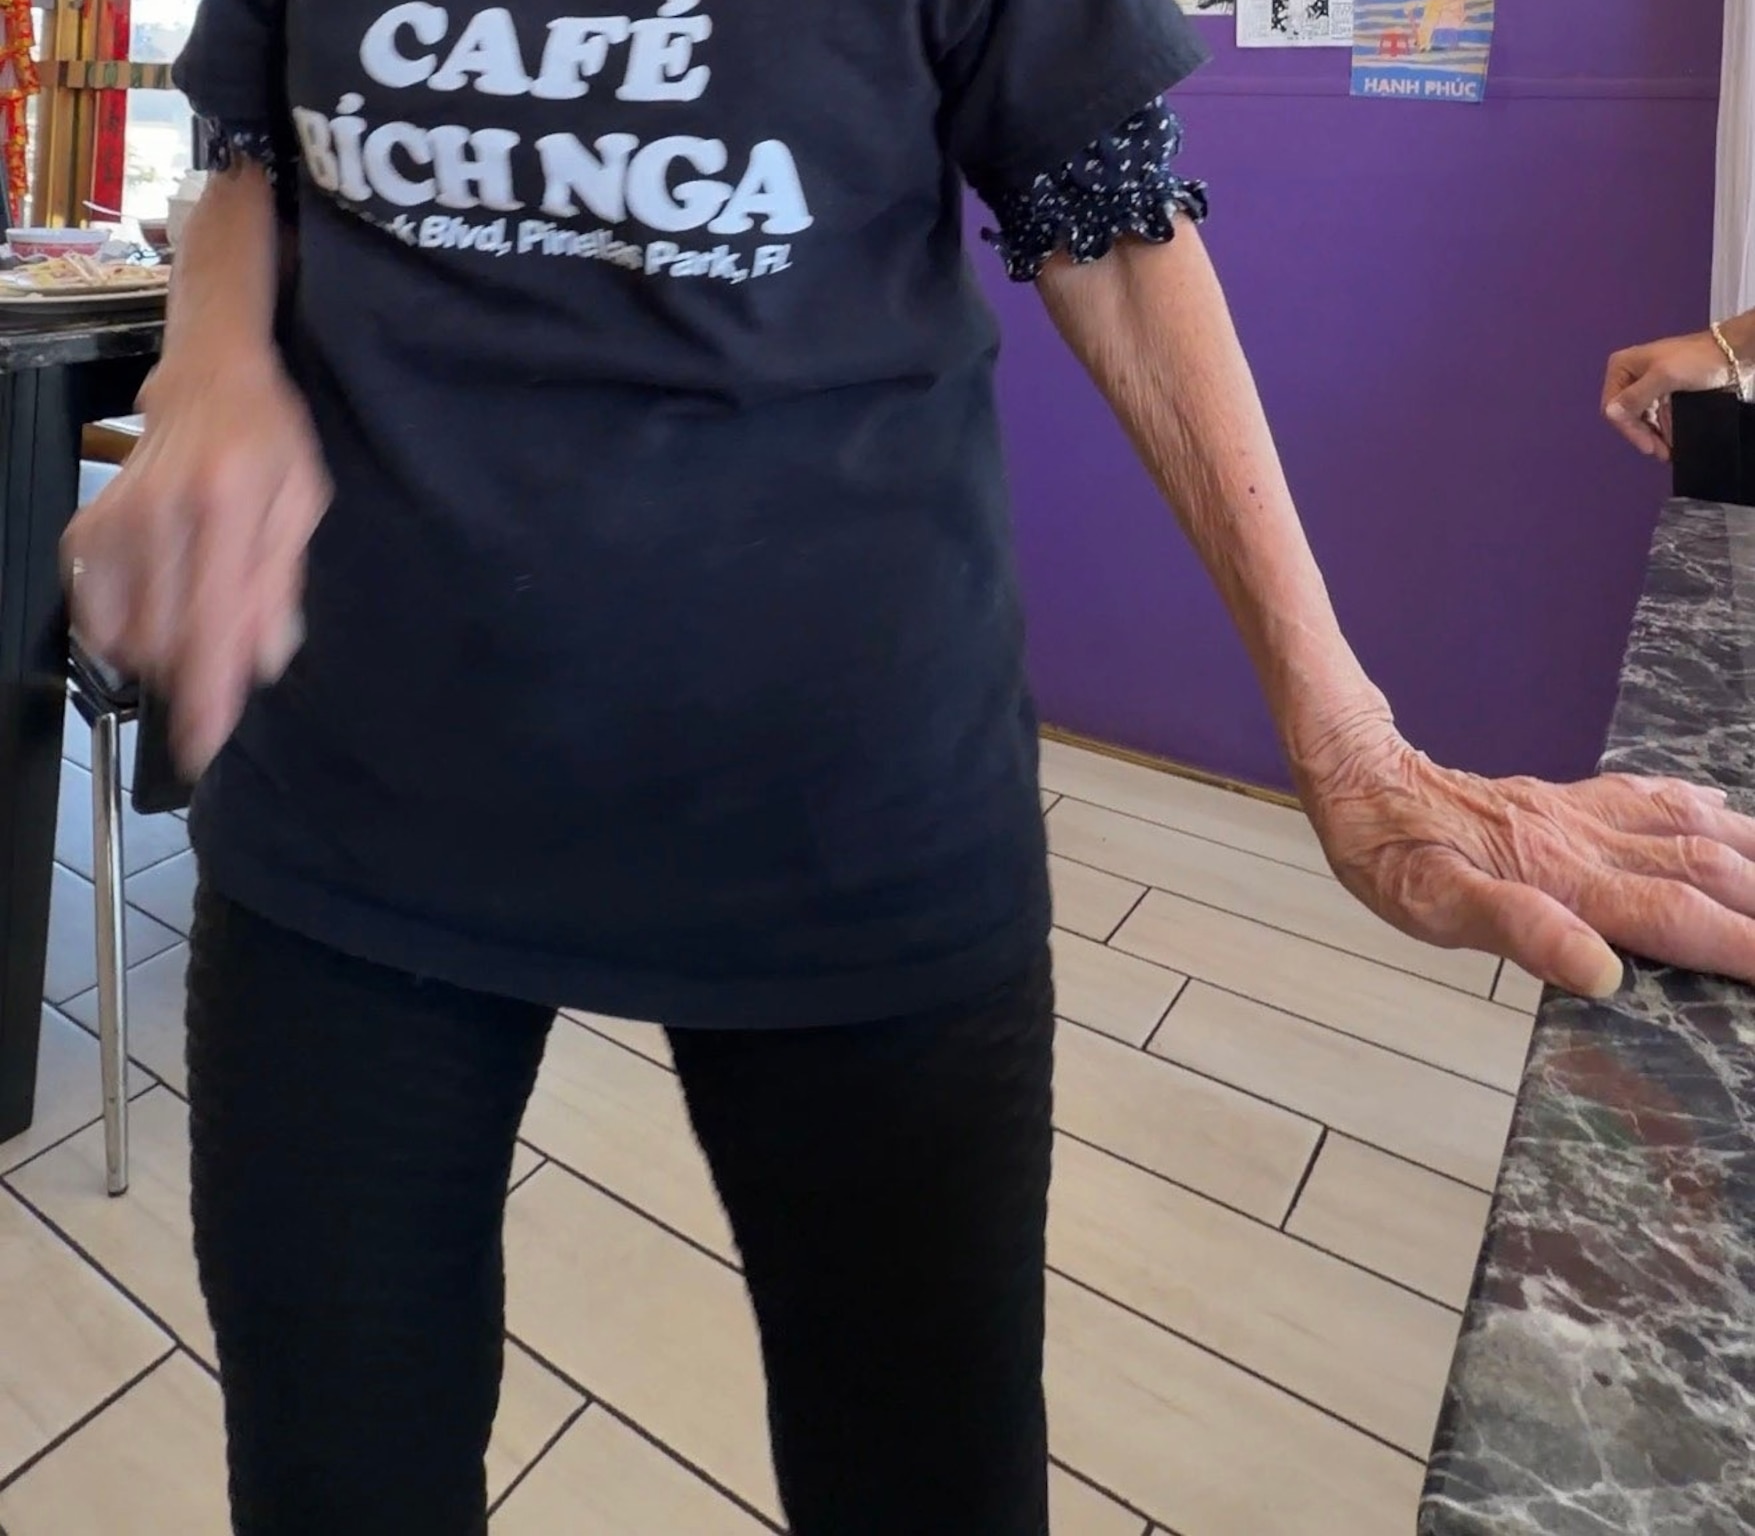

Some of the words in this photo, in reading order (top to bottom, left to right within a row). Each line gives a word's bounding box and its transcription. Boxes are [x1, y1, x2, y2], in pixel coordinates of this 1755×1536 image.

[1424, 76, 1476, 97] PHÚC
[293, 92, 526, 212] BÍCH
[535, 132, 814, 235] NGA
[418, 215, 512, 257] Blvd,
[751, 244, 792, 278] FL
